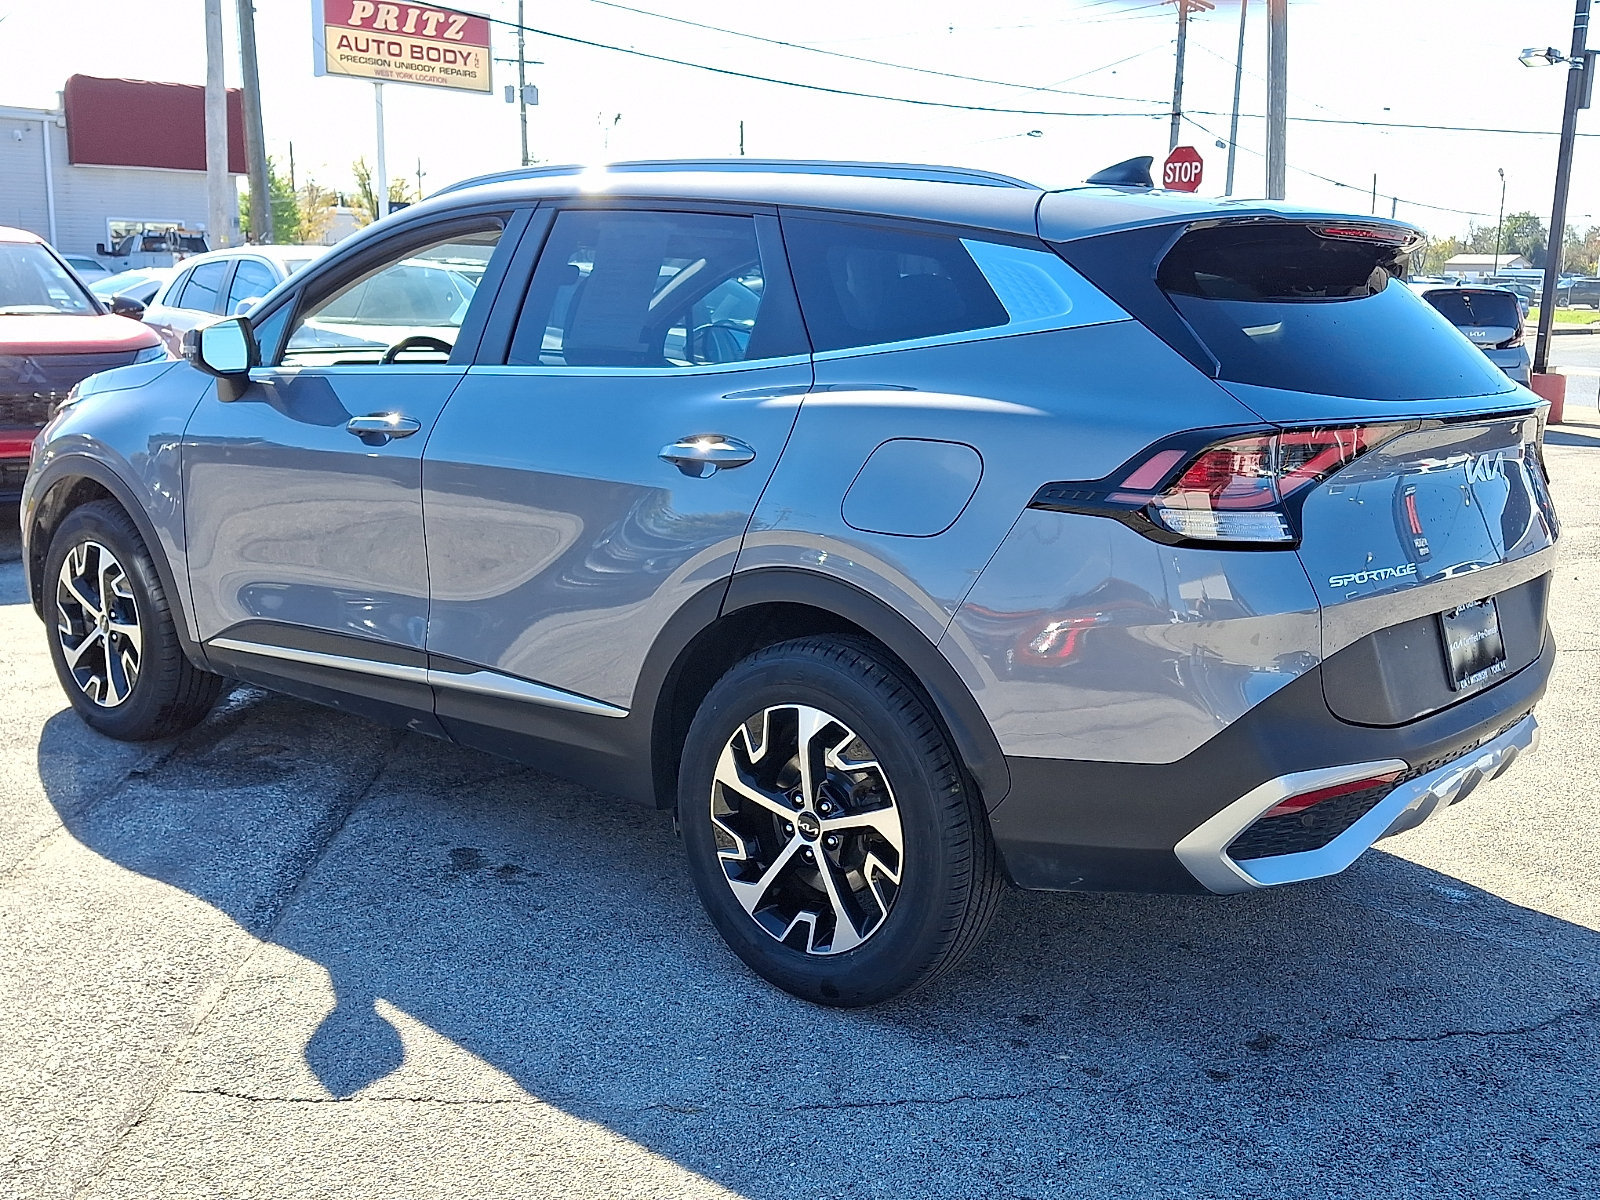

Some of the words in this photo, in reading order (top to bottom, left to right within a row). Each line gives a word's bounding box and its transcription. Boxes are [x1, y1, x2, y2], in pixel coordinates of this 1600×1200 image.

[347, 0, 468, 40] PRITZ
[336, 35, 402, 57] AUTO
[410, 44, 472, 66] BODY
[339, 54, 391, 68] PRECISION
[394, 61, 436, 73] UNIBODY
[439, 66, 477, 79] REPAIRS
[374, 69, 393, 77] WEST
[395, 71, 413, 80] YORK
[415, 74, 448, 84] LOCATION
[1164, 161, 1201, 184] STOP
[1464, 451, 1505, 484] KIA
[1329, 562, 1418, 588] SPORTAGE
[798, 819, 819, 835] KIA
